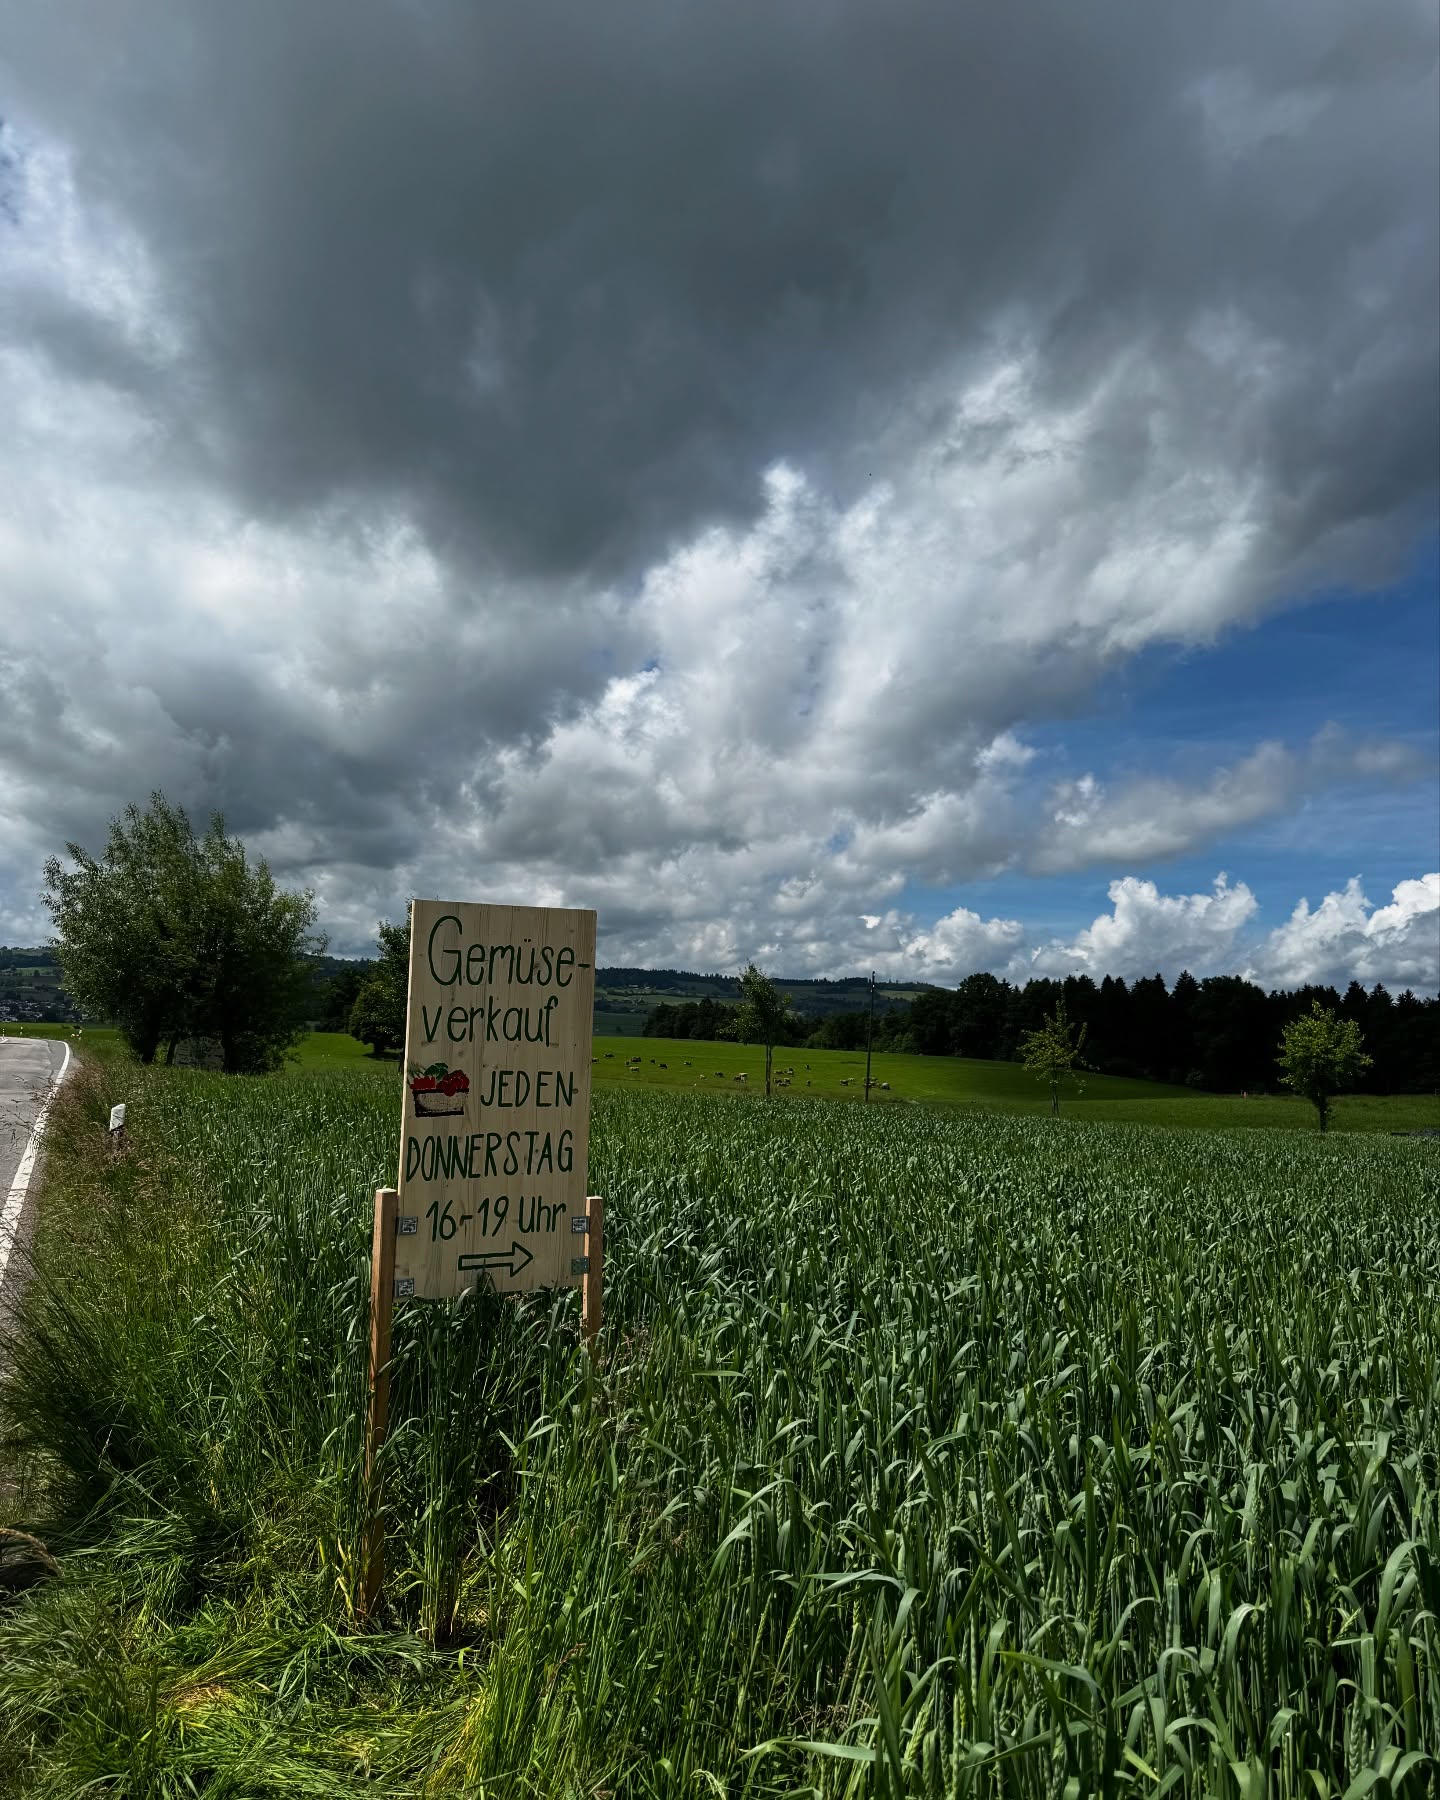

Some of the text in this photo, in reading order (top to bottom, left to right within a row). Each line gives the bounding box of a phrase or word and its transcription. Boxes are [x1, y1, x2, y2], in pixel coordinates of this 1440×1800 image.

[428, 915, 591, 987] Gemüse-
[422, 995, 559, 1047] verkauf
[480, 1070, 574, 1107] JEDEN
[406, 1129, 573, 1183] DONNERSTAG
[425, 1195, 567, 1242] 16-19 Uhr
